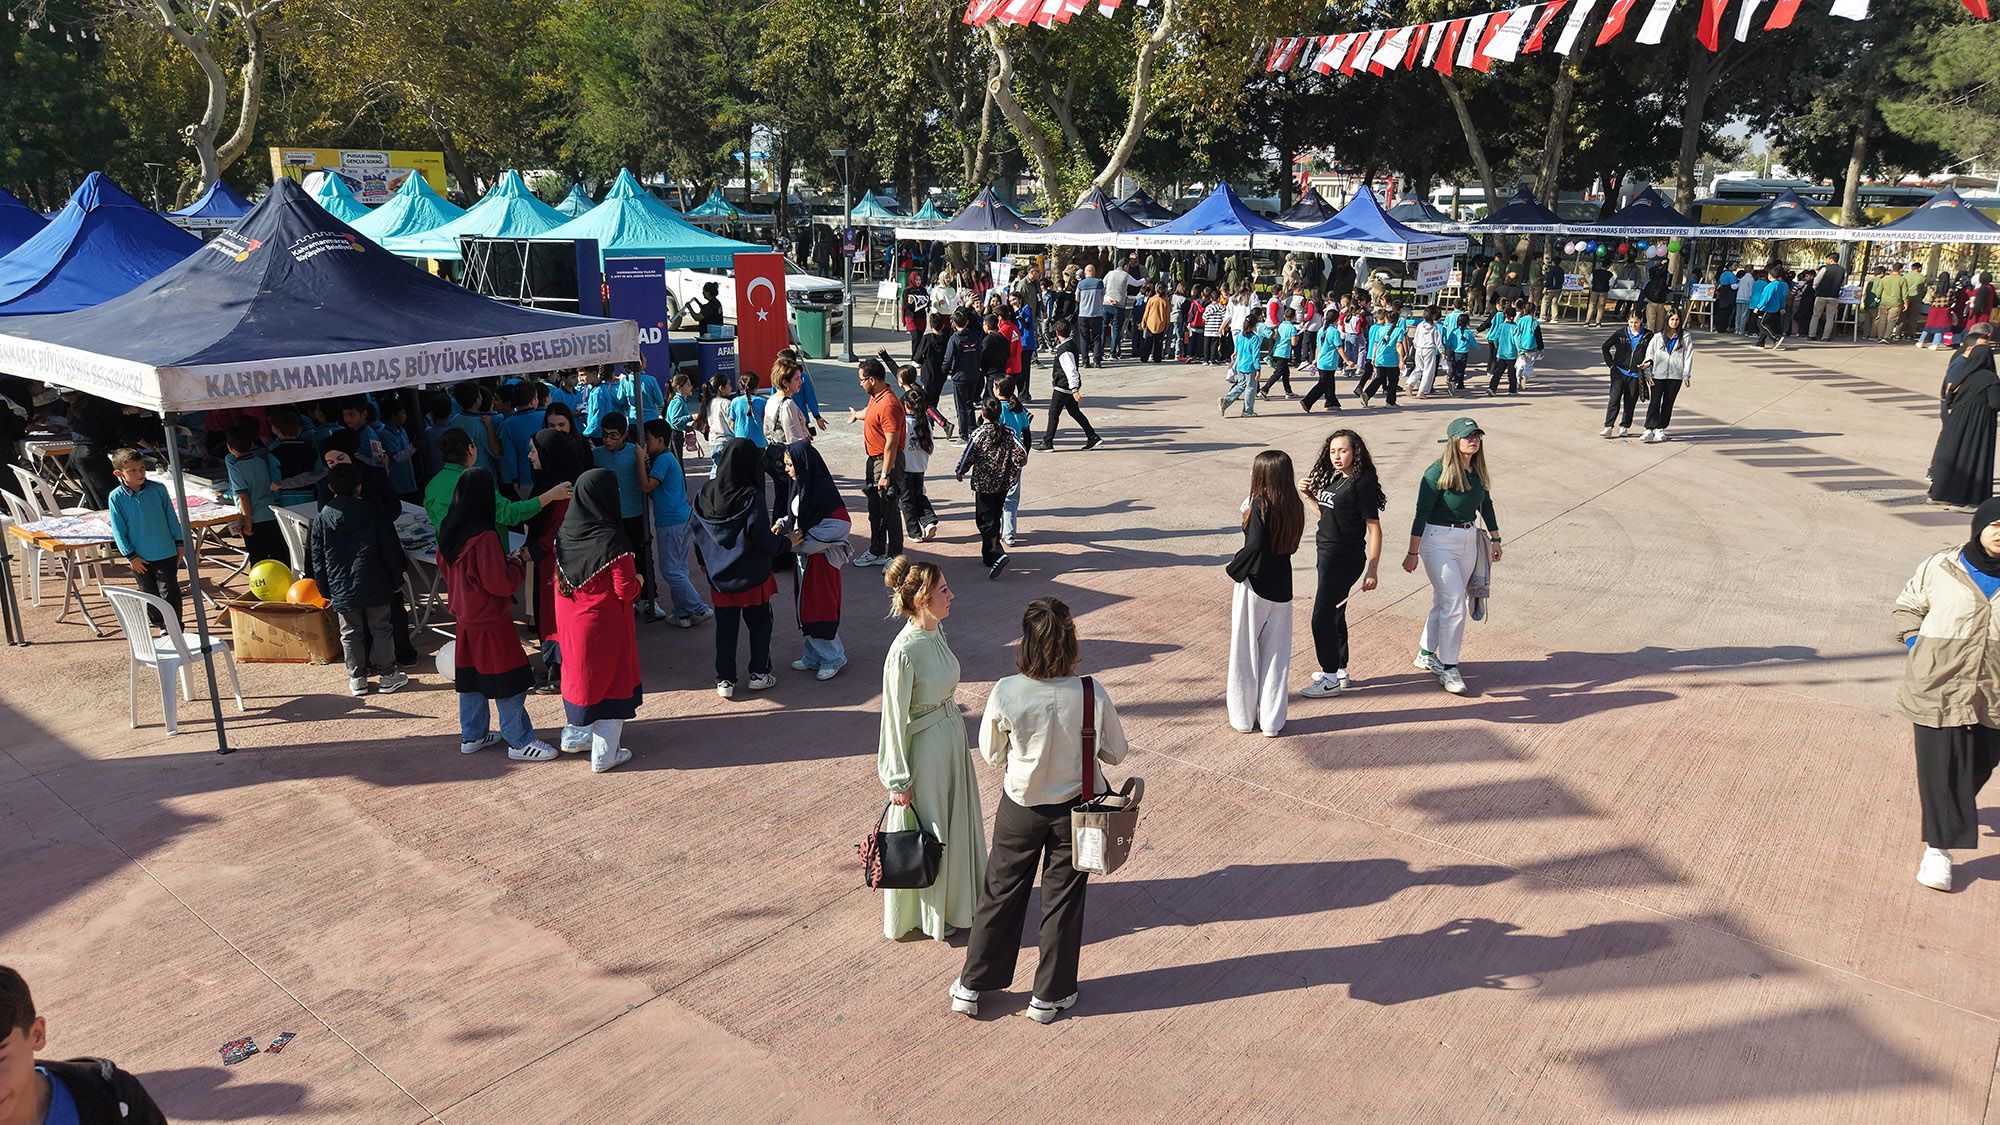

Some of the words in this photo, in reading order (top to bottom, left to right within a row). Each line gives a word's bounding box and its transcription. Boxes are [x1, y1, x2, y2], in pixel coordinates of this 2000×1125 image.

[205, 358, 401, 398] KAHRAMANMARAŞ
[405, 335, 518, 379] BÜYÜKŞEHİR
[521, 328, 611, 361] BELEDİYESİ
